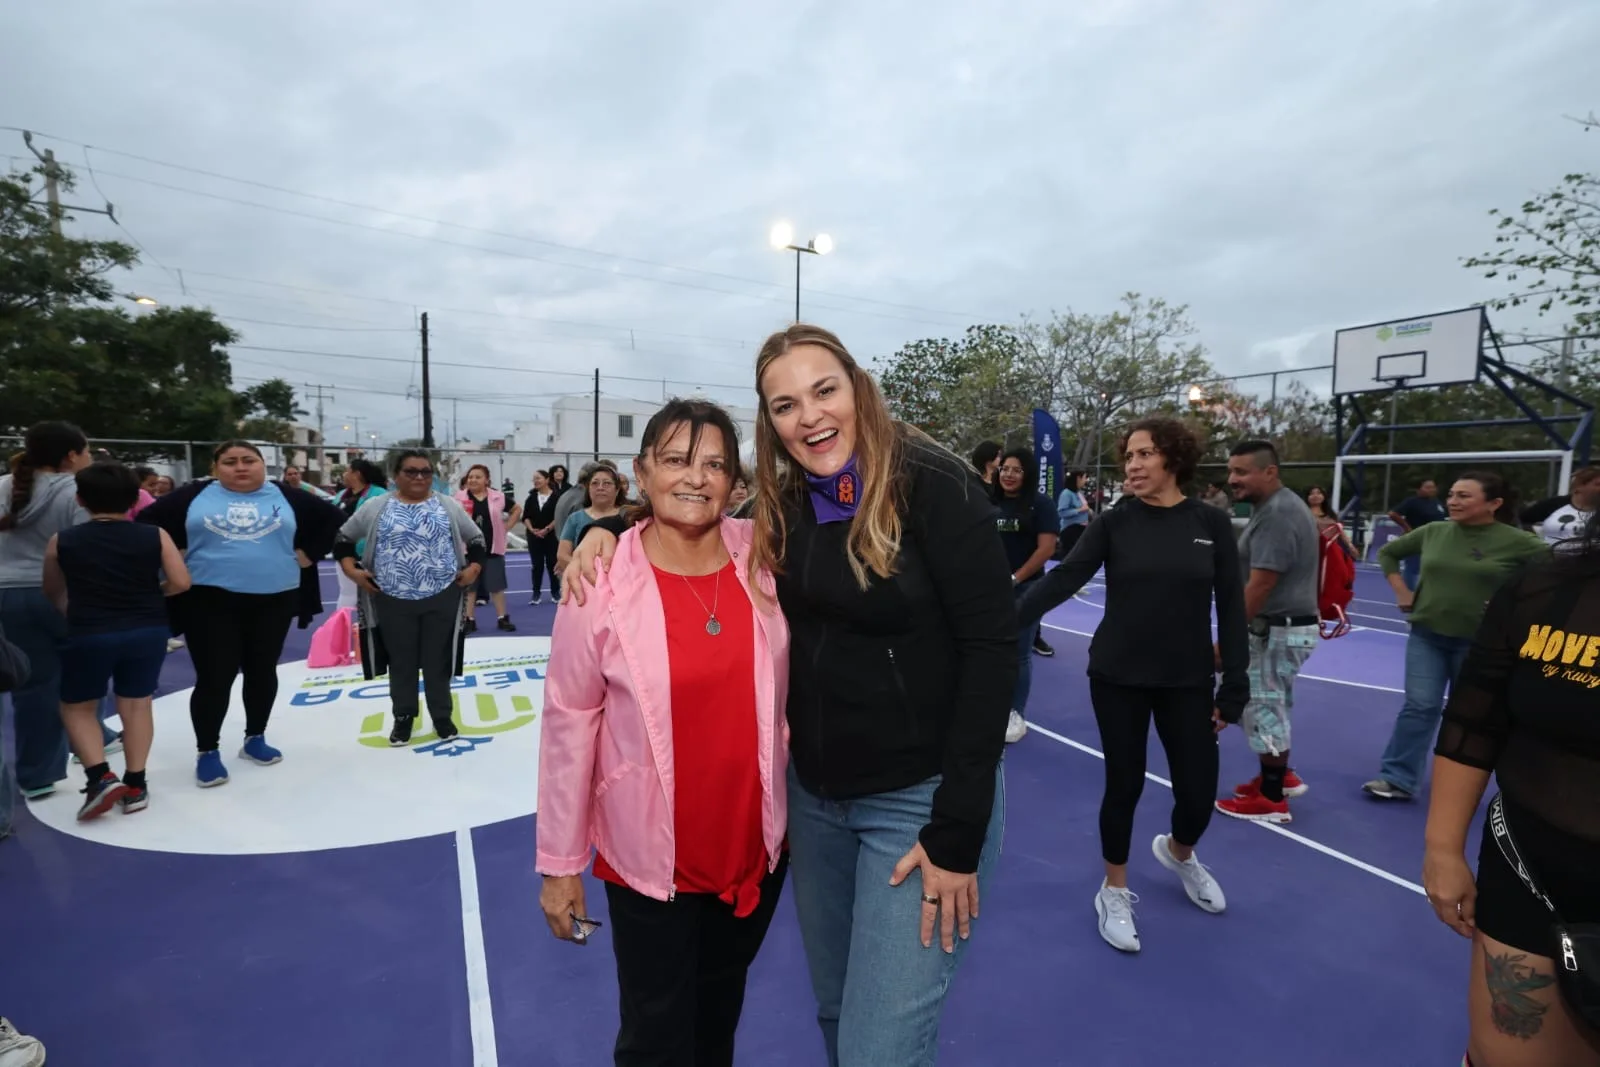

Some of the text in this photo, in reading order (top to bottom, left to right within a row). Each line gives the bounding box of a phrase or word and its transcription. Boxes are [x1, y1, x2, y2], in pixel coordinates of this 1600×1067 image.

[1038, 456, 1047, 494] ORTES
[1520, 624, 1600, 667] MOVE
[1493, 796, 1506, 837] BIM
